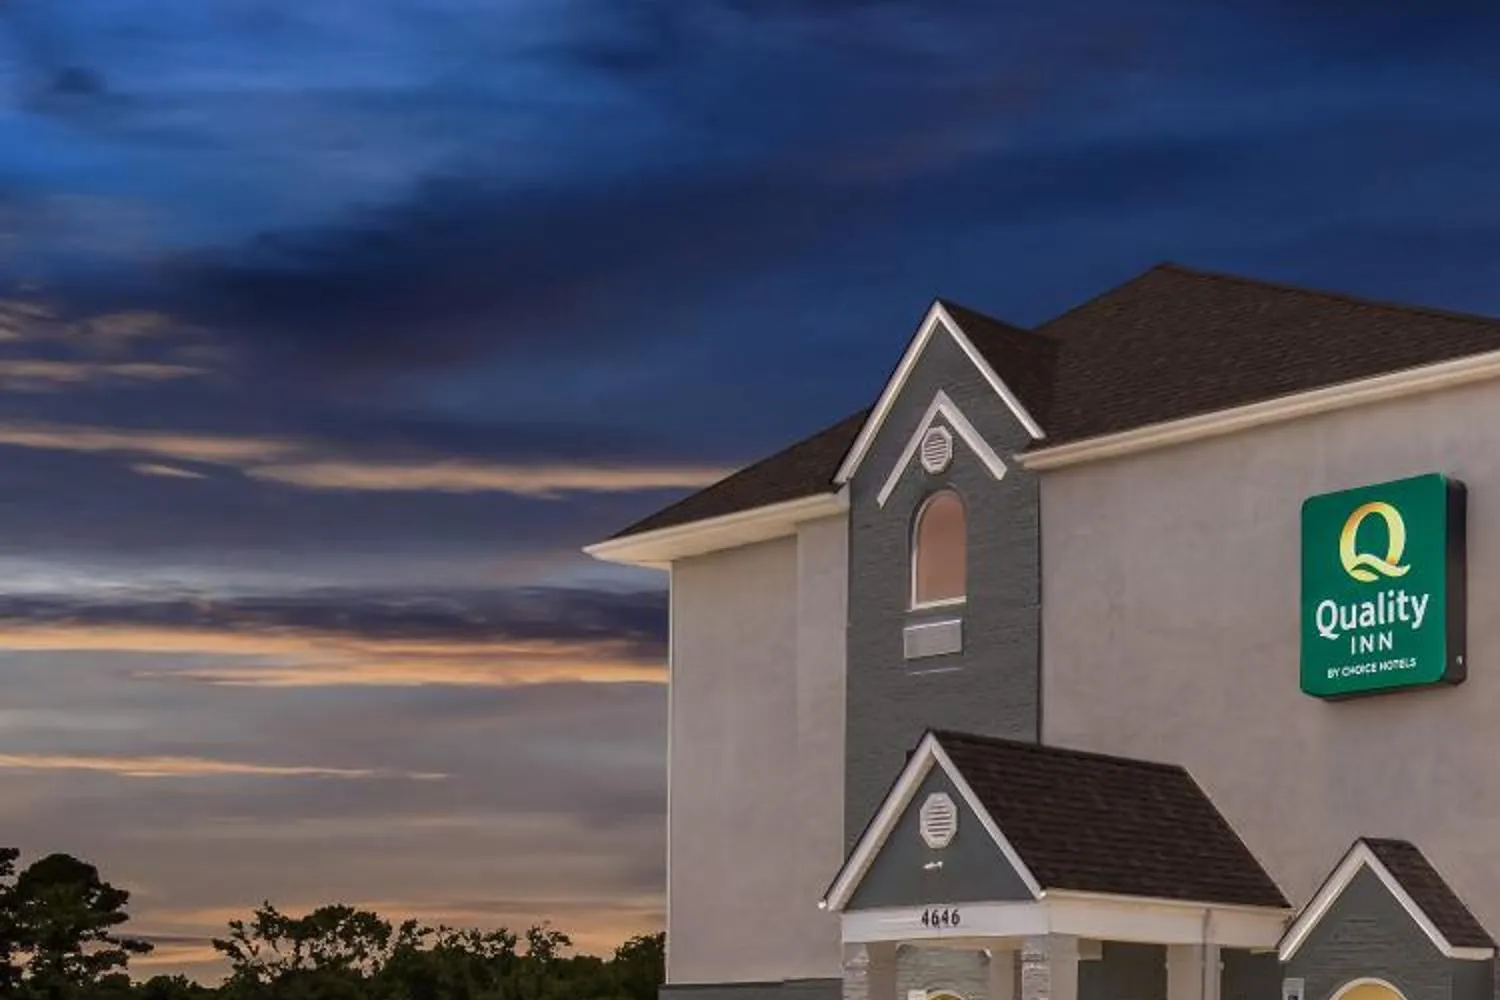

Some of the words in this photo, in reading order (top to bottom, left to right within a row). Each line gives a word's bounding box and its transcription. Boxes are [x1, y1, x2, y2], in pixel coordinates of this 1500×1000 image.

[1339, 501, 1411, 583] Q
[1315, 589, 1430, 640] Quality
[1350, 630, 1394, 656] INN
[1327, 667, 1340, 679] BY
[1341, 662, 1377, 678] CHOICE
[1379, 657, 1417, 671] HOTELS
[921, 908, 961, 929] 4646
